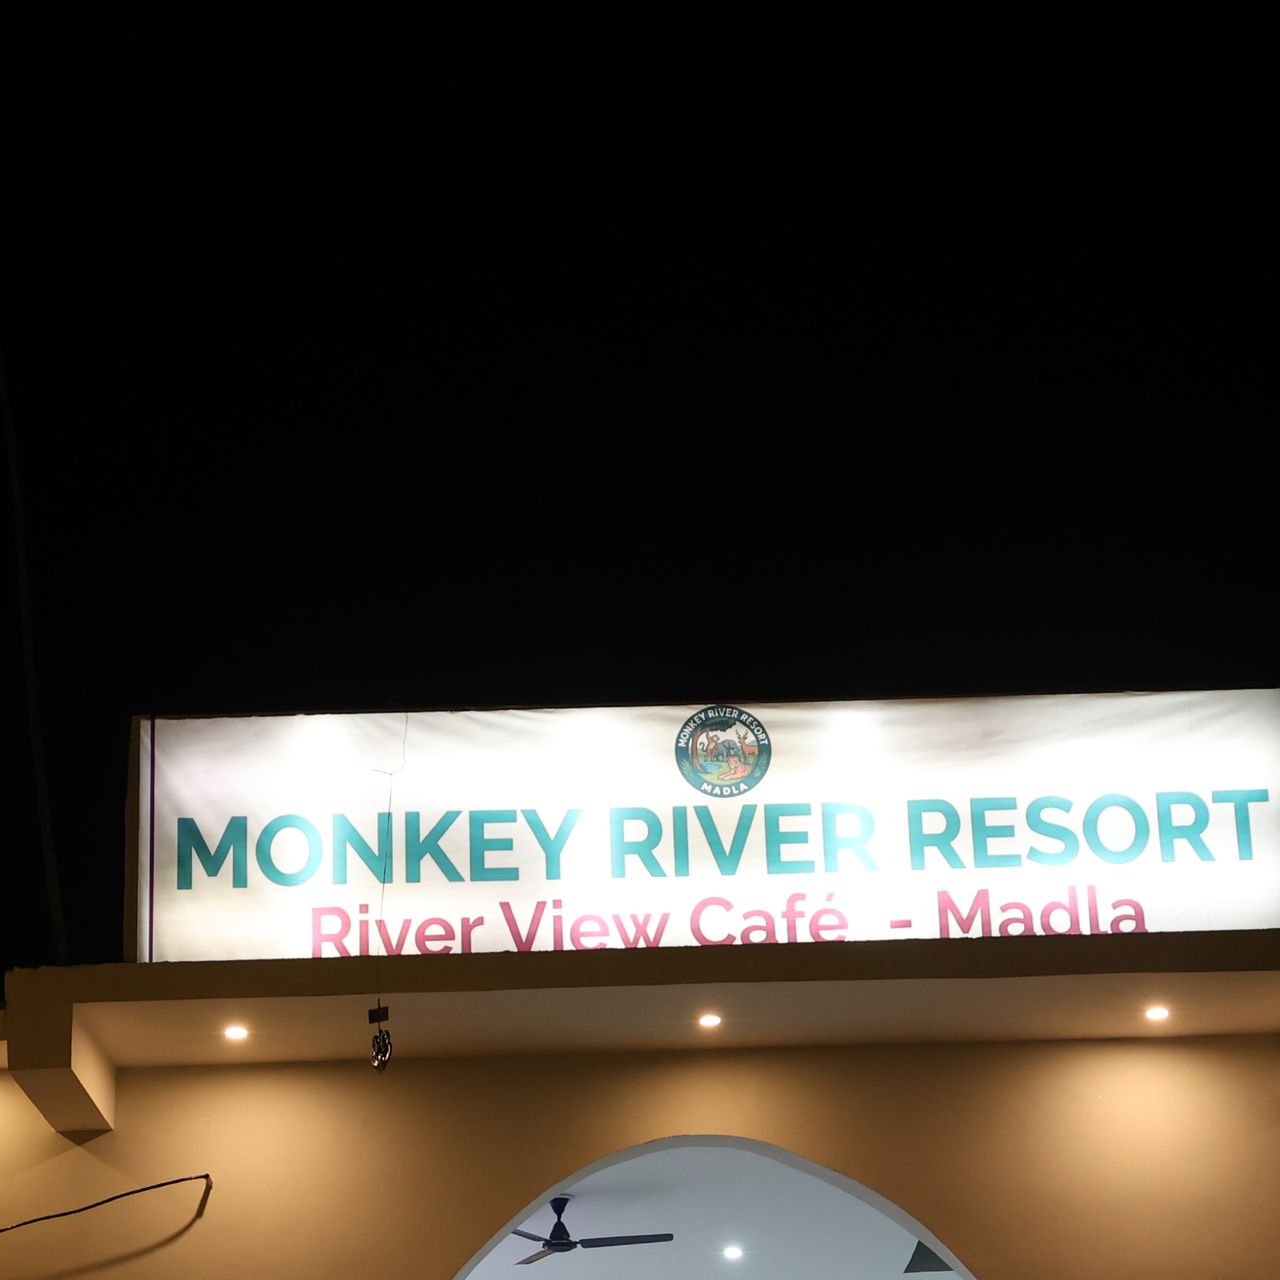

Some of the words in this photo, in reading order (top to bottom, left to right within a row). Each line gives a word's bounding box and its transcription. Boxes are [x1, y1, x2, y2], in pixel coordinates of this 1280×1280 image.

[678, 712, 706, 748] MONKEY
[707, 708, 739, 719] RIVER
[740, 713, 769, 746] RESORT
[700, 781, 749, 796] MADLA
[177, 808, 581, 889] MONKEY
[610, 802, 876, 878] RIVER
[907, 789, 1271, 870] RESORT
[311, 903, 485, 959] River
[498, 898, 671, 952] View
[689, 892, 850, 946] Café
[890, 919, 913, 929] -
[937, 886, 1150, 938] Madla
